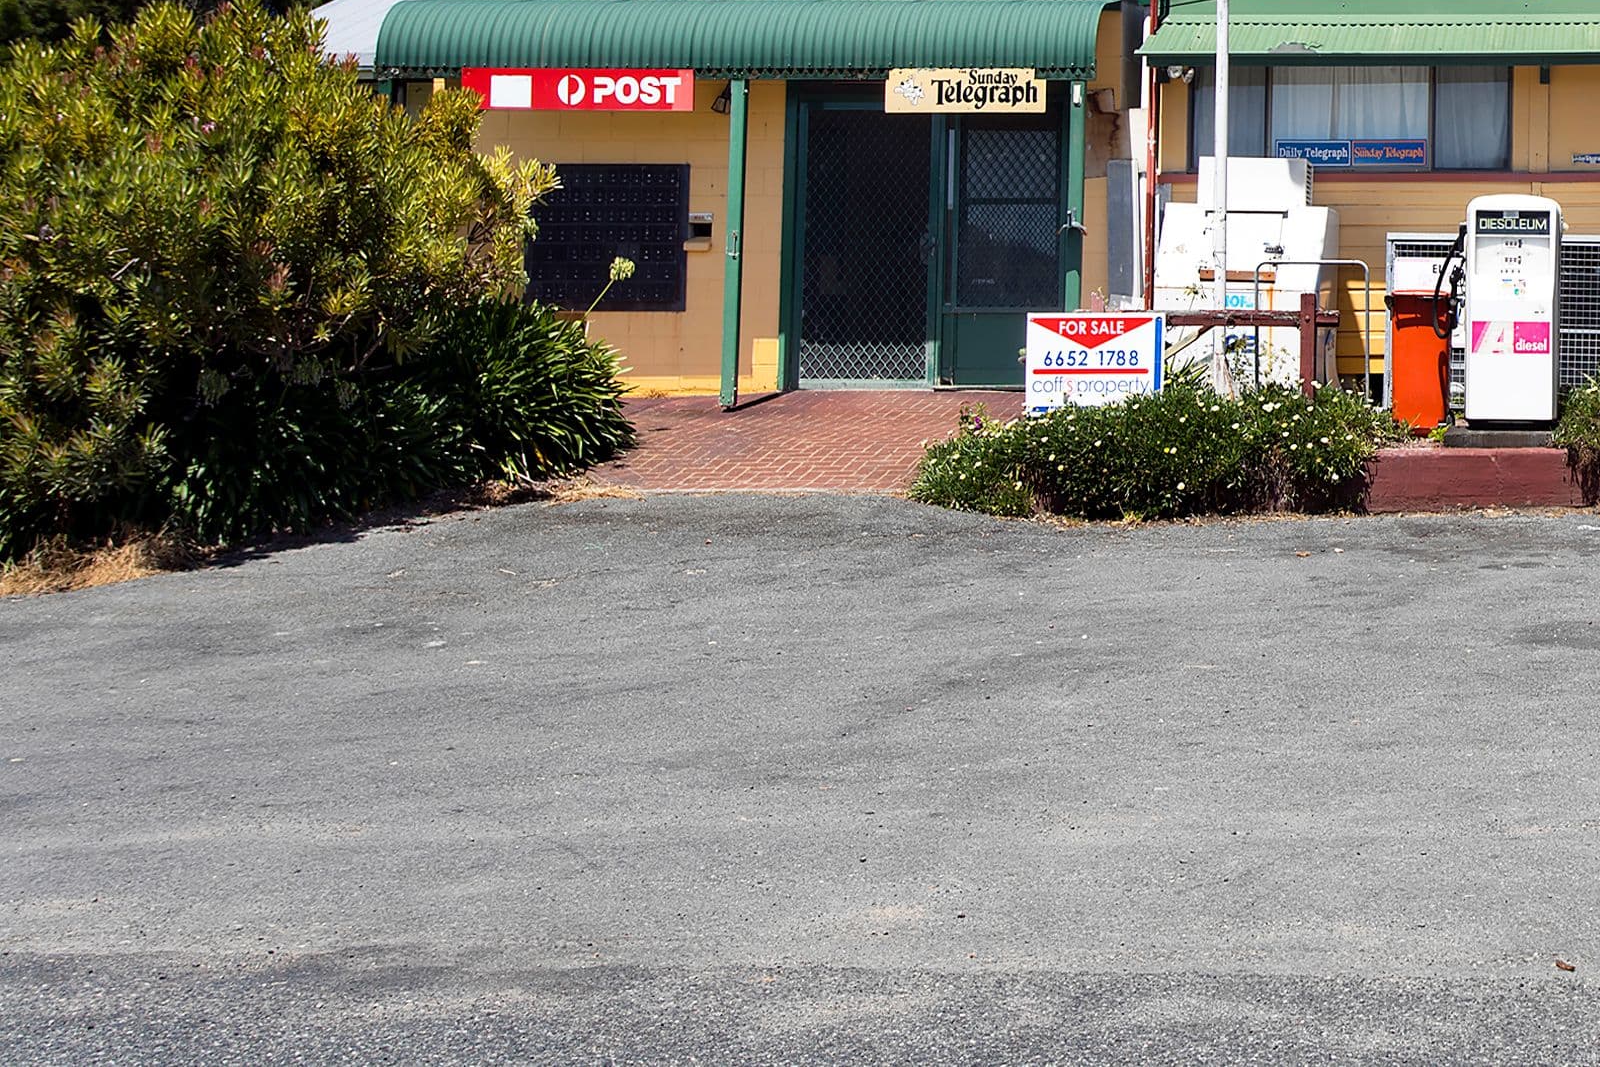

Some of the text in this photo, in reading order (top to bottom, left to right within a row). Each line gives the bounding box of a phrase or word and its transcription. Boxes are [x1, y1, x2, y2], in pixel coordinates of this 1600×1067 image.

[968, 69, 1018, 86] Sunday
[593, 76, 682, 105] POST
[931, 79, 1038, 110] Telegraph
[1279, 146, 1348, 160] Daily Telegraph
[1354, 146, 1424, 160] Sunday Telegraph
[1479, 217, 1547, 230] DIESOLEUM
[1058, 320, 1125, 335] FOR SALE
[1515, 338, 1547, 351] diesel
[1043, 350, 1139, 367] 6652 1788
[1077, 376, 1150, 397] property
